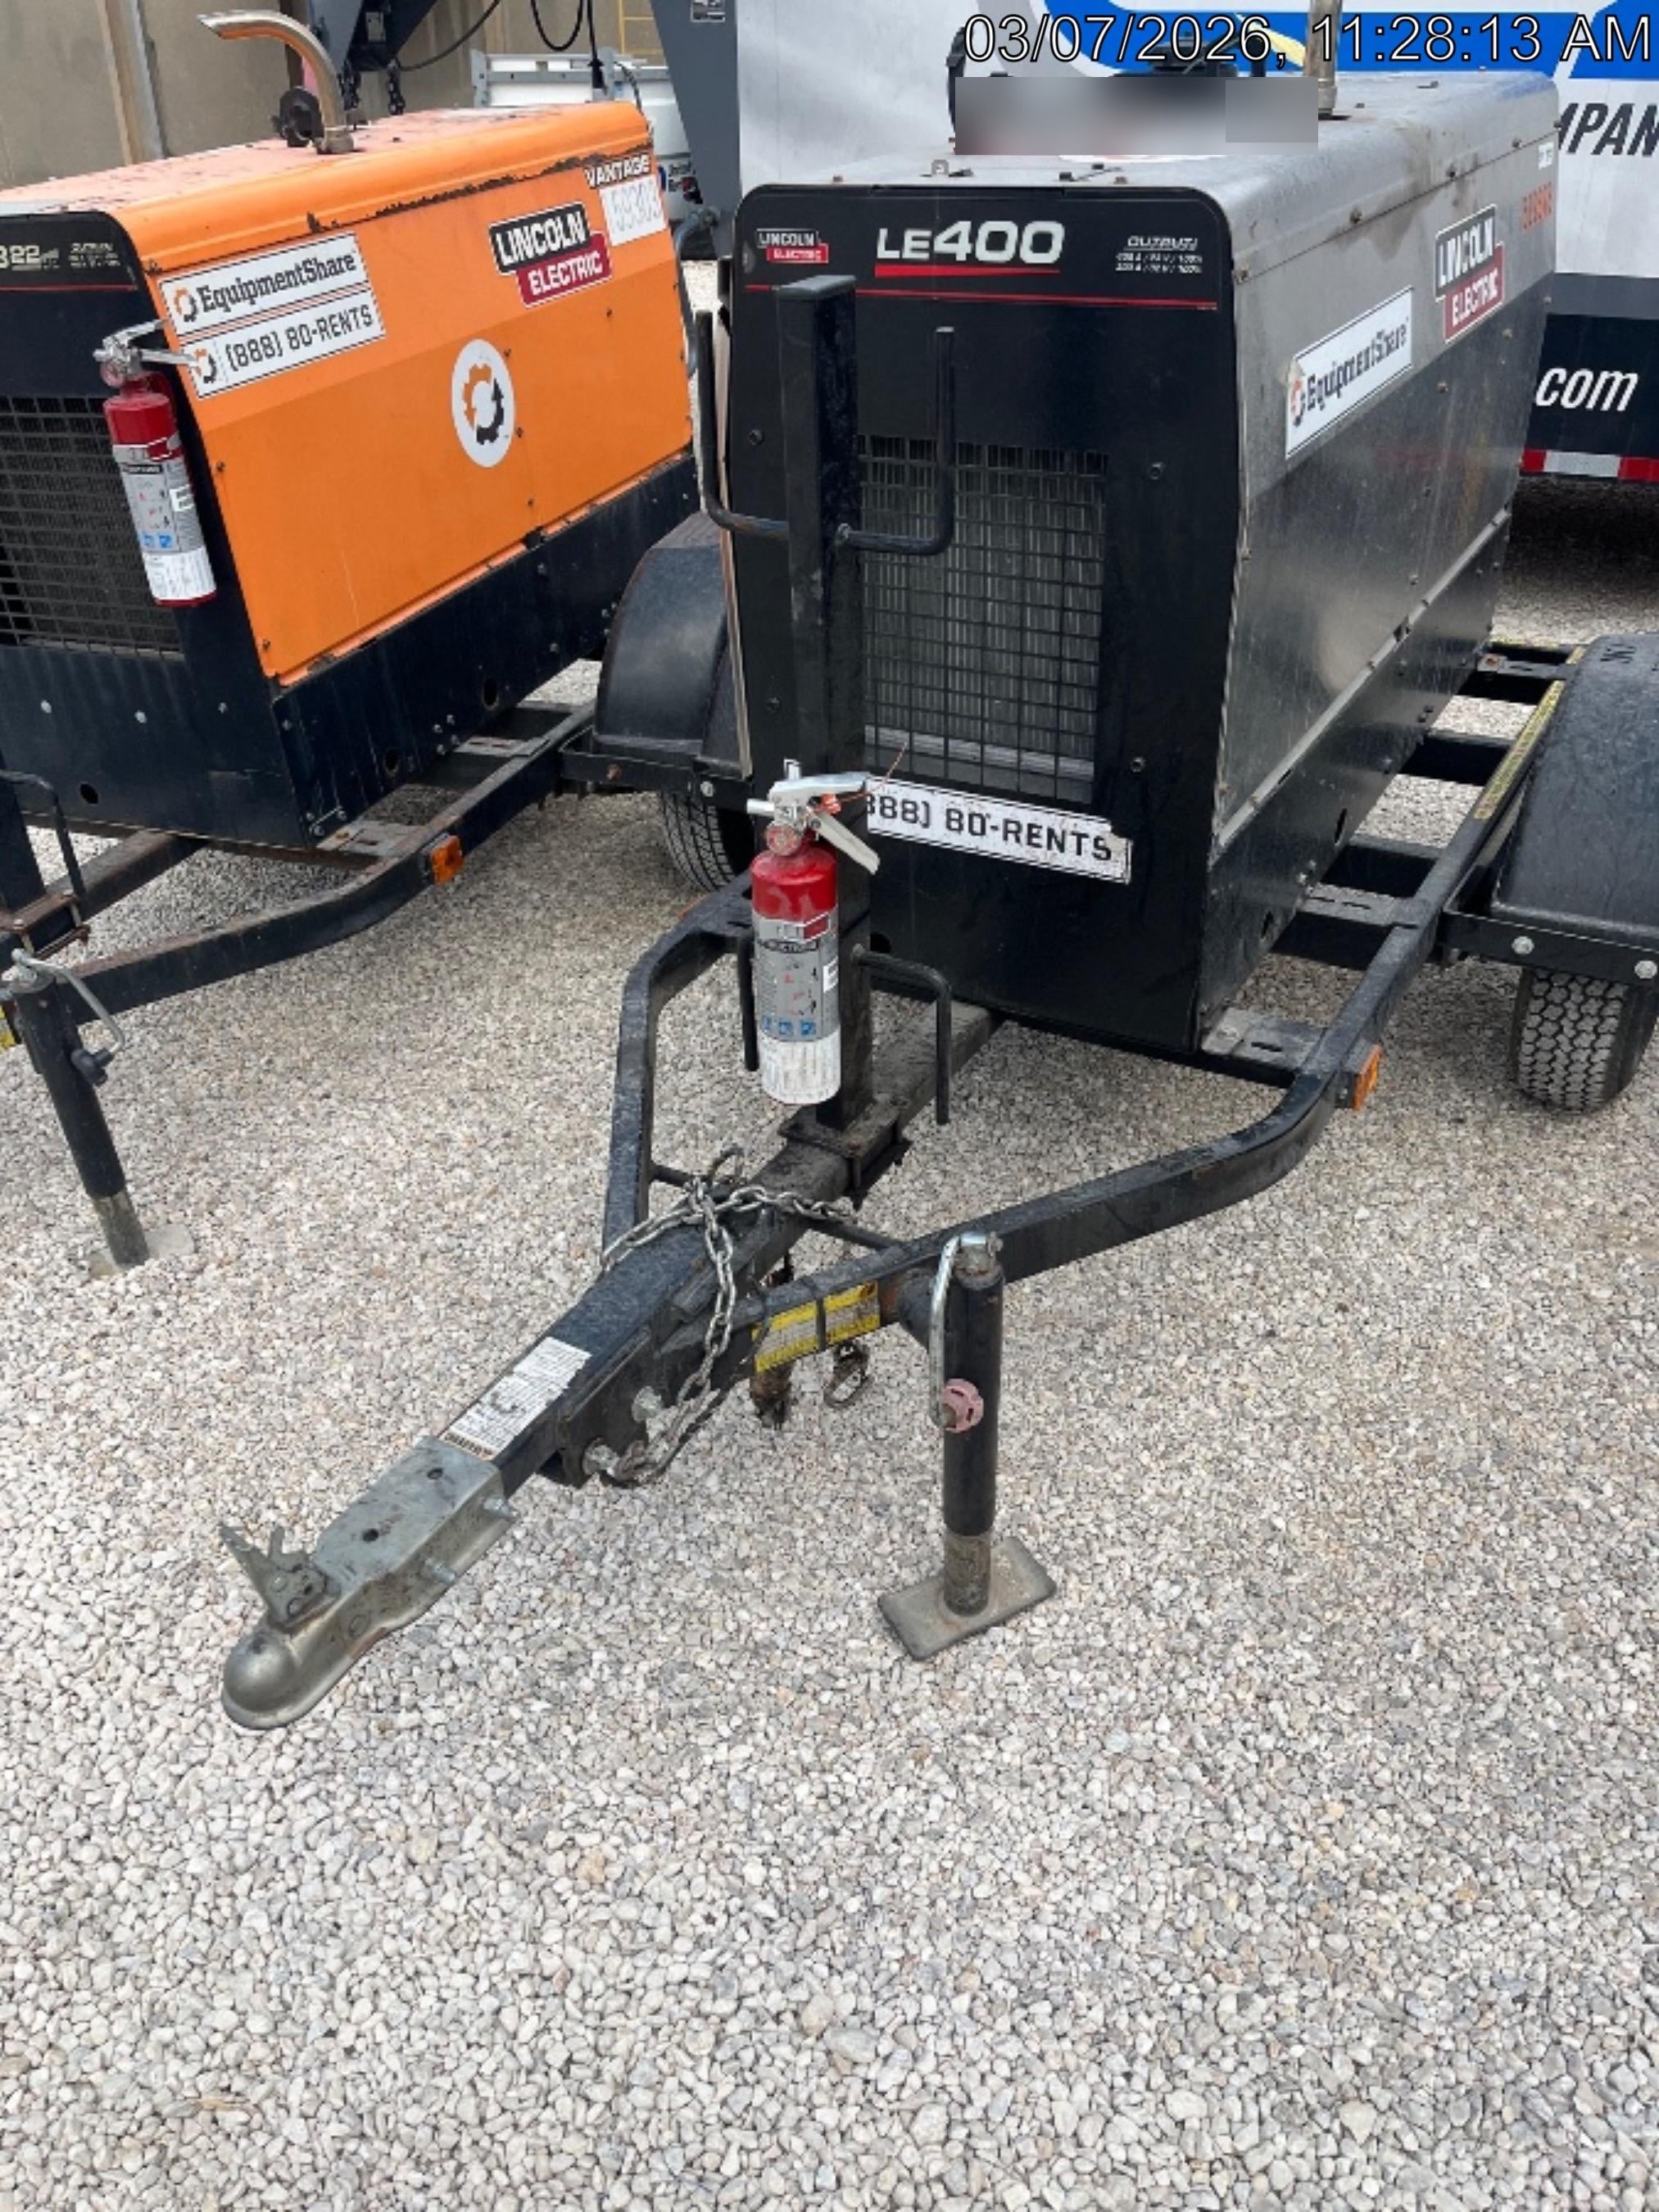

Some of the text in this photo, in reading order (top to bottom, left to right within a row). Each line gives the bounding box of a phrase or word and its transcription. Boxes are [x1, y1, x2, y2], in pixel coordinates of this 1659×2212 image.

[584, 154, 650, 188] VANTAGE
[495, 211, 587, 266] LINCOLN
[758, 232, 815, 247] LINCOLN
[876, 220, 1065, 265] LE400
[1439, 216, 1494, 288] LINCOLN
[195, 252, 357, 313] EquipmentShare
[527, 250, 603, 296] ELECTRIC
[224, 303, 374, 372] (888) 80-RENTS
[1307, 323, 1407, 411] EquipmentShare
[945, 807, 1113, 861] 80-RENTS
